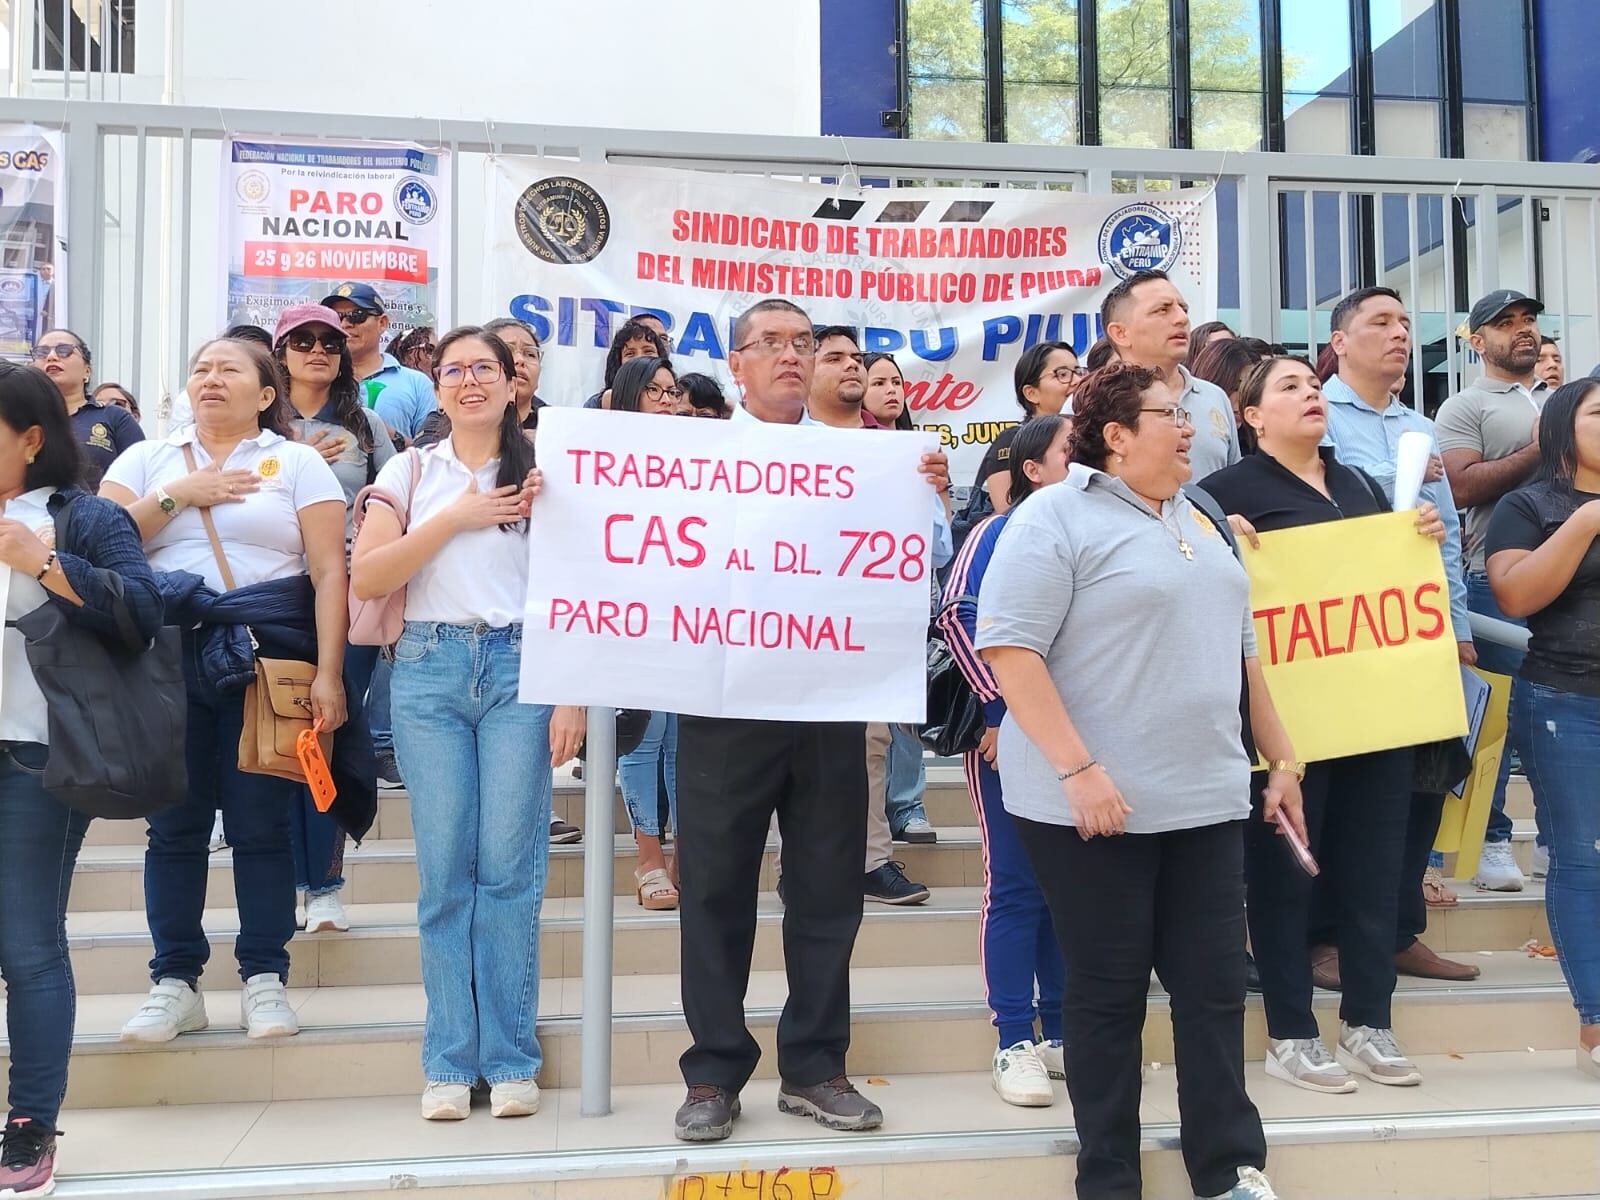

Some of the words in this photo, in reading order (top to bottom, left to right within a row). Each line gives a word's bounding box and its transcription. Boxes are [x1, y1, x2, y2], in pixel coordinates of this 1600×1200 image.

[277, 152, 305, 164] NACIONAL
[307, 154, 316, 164] DE
[363, 156, 374, 167] DEL
[281, 168, 295, 177] Por
[297, 169, 305, 177] la
[307, 170, 366, 181] reivindicación
[367, 172, 395, 181] laboral
[289, 188, 383, 215] PARO
[550, 180, 596, 201] LABORALES
[592, 200, 607, 229] JUNTOS
[262, 216, 409, 241] NACIONAL
[672, 208, 819, 253] SINDICATO
[826, 224, 859, 256] DE
[865, 226, 1068, 259] TRABAJADORES
[255, 249, 276, 267] 25
[294, 250, 317, 268] 26
[320, 249, 418, 273] NOVIEMBRE
[636, 251, 685, 286] DEL
[691, 257, 853, 300] MINISTERIO
[860, 267, 977, 304] PÚBLICO
[982, 272, 1015, 302] DE
[246, 295, 295, 307] Exigimos
[384, 300, 414, 311] ebate
[566, 448, 855, 499] TRABAJADORES
[603, 513, 708, 568] CAS
[724, 547, 755, 572] AL
[774, 540, 822, 576] D.L.
[837, 529, 926, 583] 728
[549, 598, 648, 638] PARO
[672, 604, 865, 652] NACIONAL
